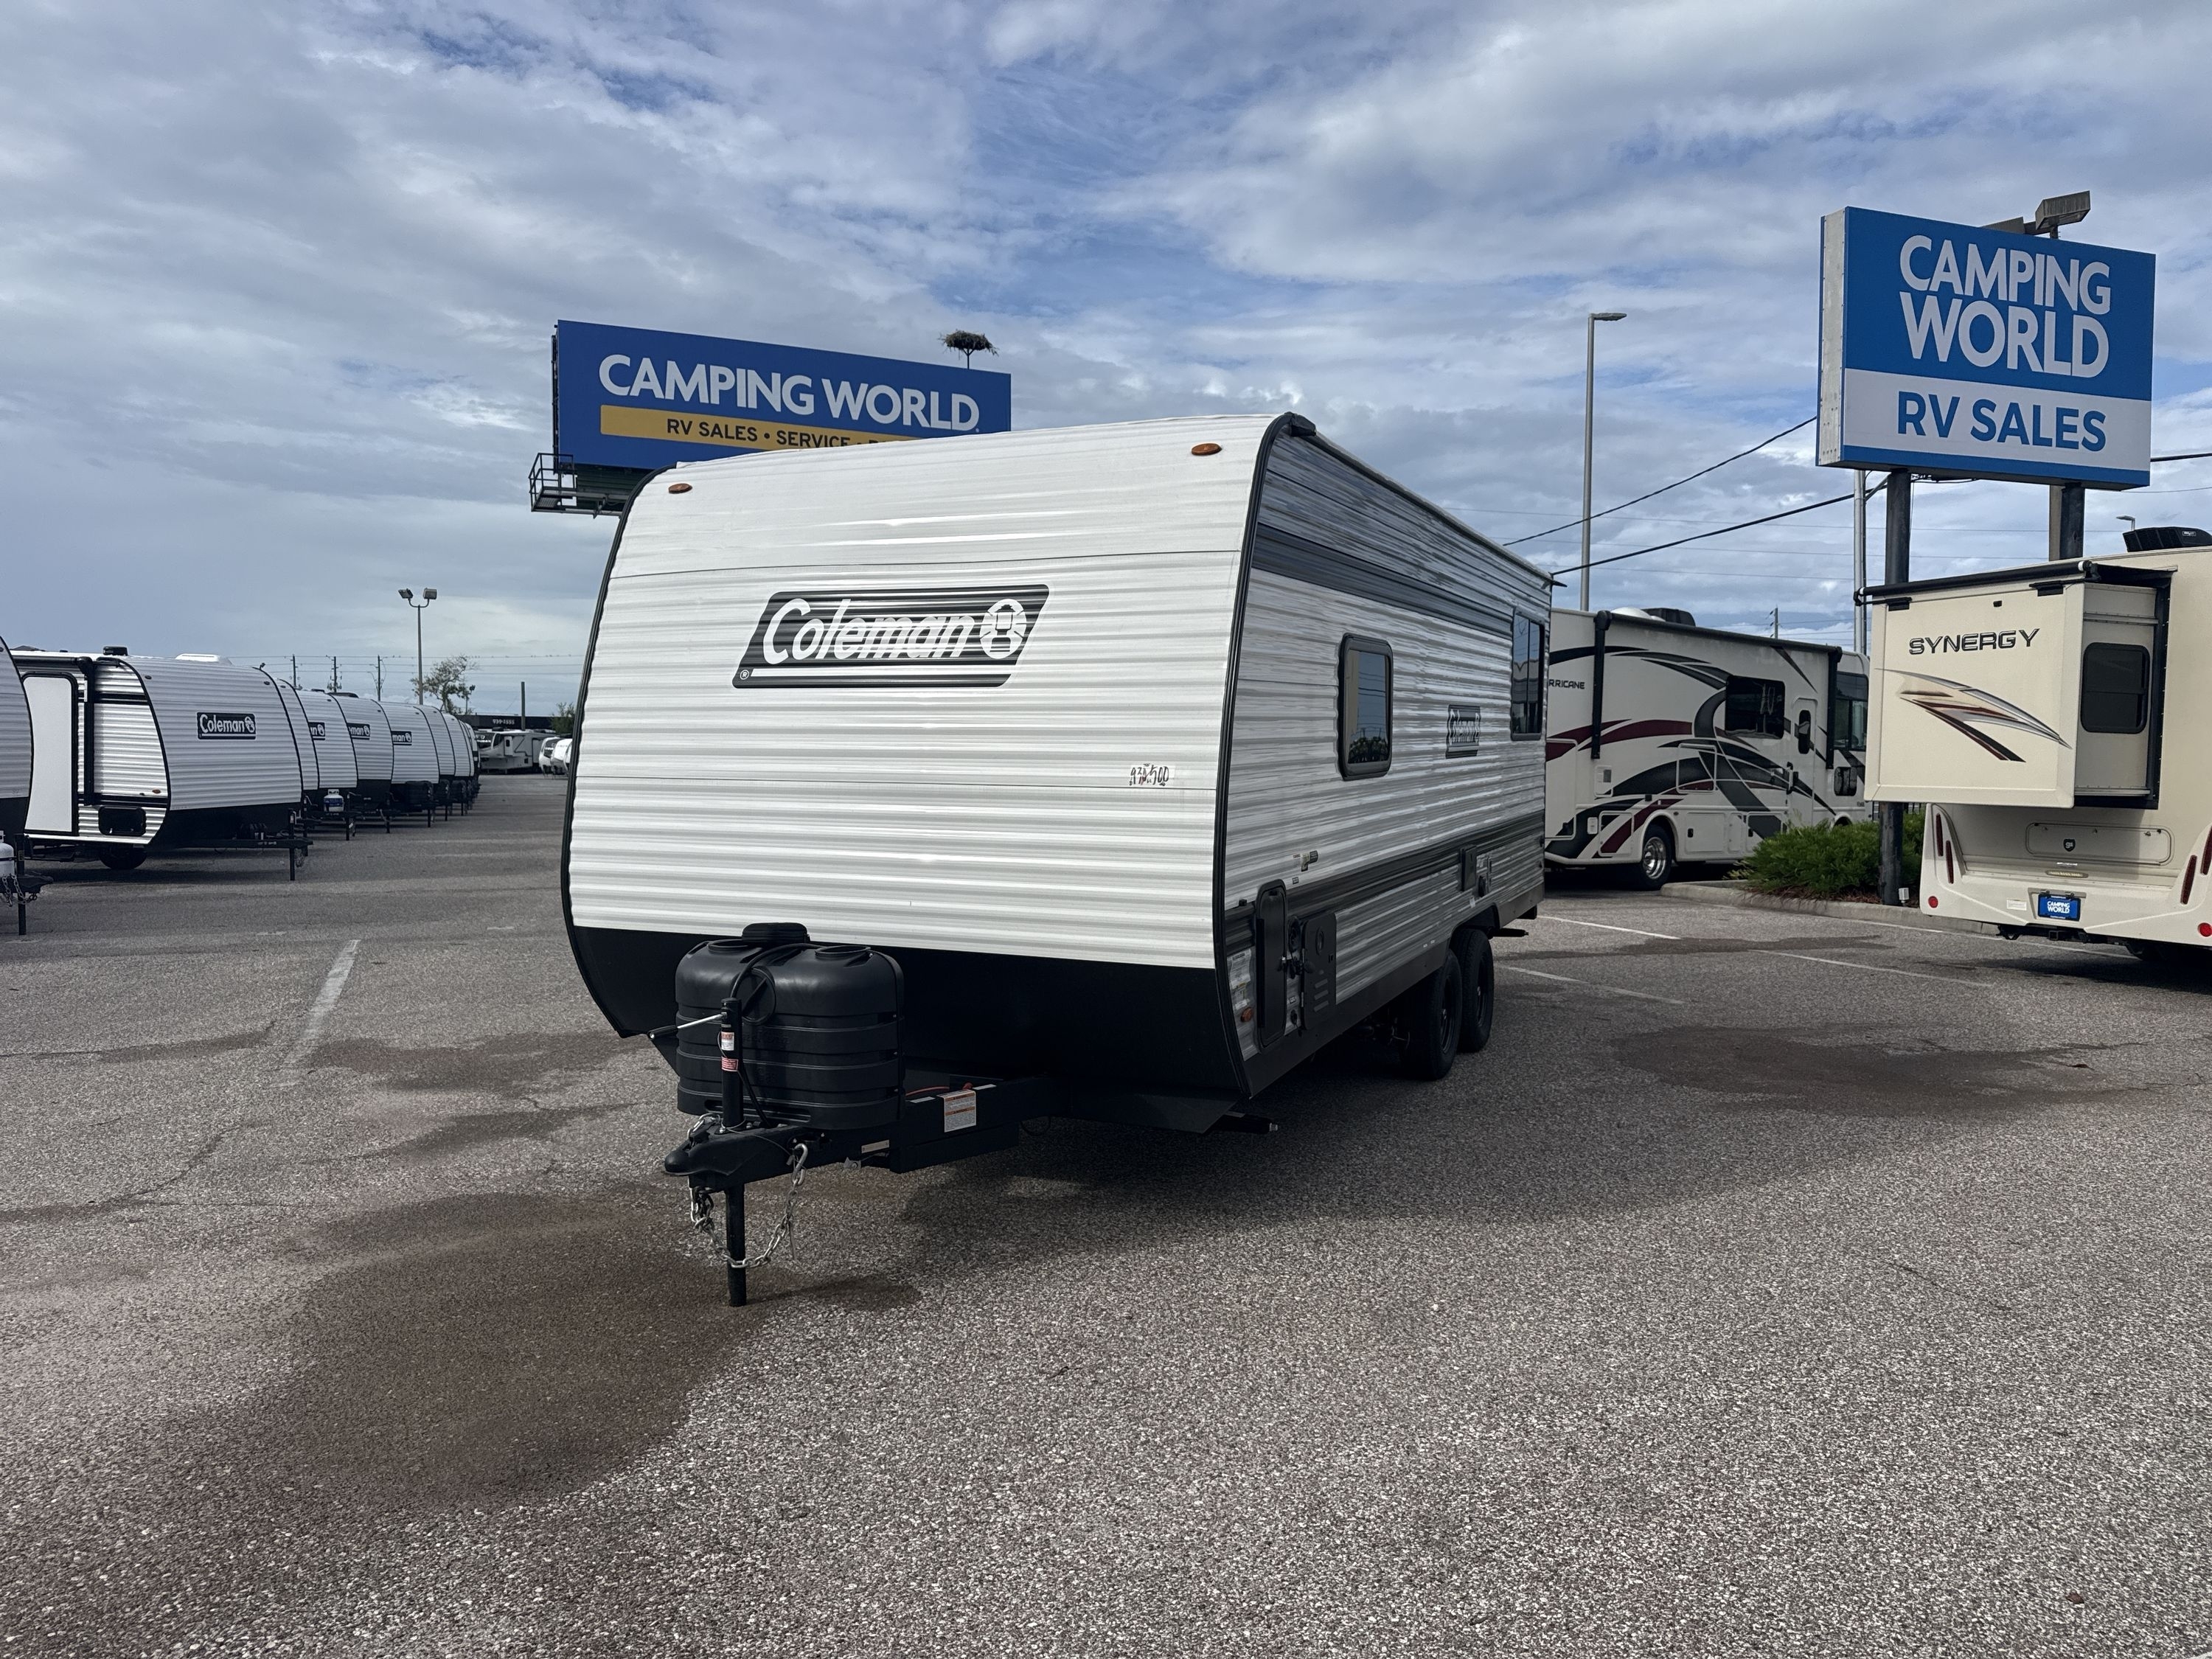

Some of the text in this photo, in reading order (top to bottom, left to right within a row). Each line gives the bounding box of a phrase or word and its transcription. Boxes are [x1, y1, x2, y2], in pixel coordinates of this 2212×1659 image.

[1899, 234, 2111, 315] CAMPING
[1899, 291, 2110, 378] WORLD
[599, 354, 980, 431] CAMPING WORLD
[667, 418, 851, 448] RV SALES SERVICE
[1897, 391, 2107, 451] RV SALES
[762, 598, 975, 665] Coleman
[1908, 627, 2041, 655] SYNERGY
[1548, 679, 1585, 689] RRICANE
[199, 714, 245, 734] Coleman
[1447, 709, 1475, 745] Coleman
[2047, 905, 2070, 914] WORLD
